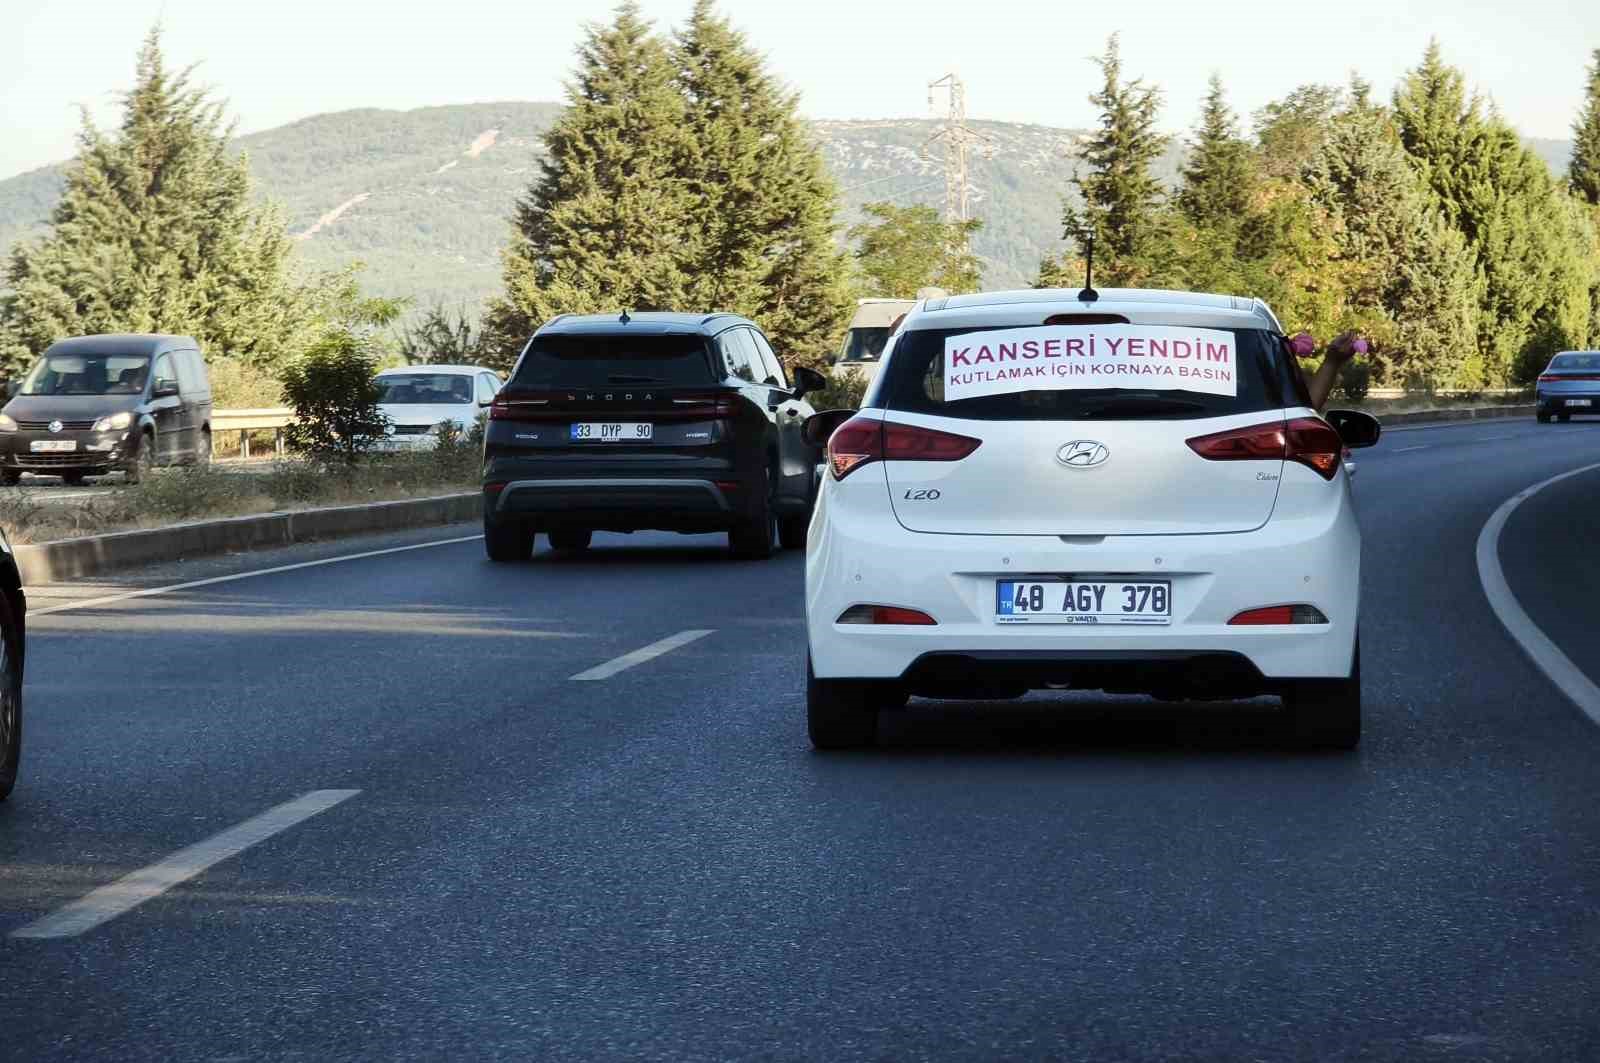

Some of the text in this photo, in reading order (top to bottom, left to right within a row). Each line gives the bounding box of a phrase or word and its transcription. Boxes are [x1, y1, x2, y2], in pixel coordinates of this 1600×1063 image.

[952, 333, 1229, 368] KANSERİ YENDİM
[950, 363, 1231, 387] KUTLAMAK İÇİN KORNAYA BASIN
[577, 424, 650, 437] 33 DYP 90
[1014, 584, 1044, 612] 48
[1062, 584, 1106, 612] AGY
[1121, 585, 1167, 613] 378
[1074, 615, 1098, 623] VARTA
